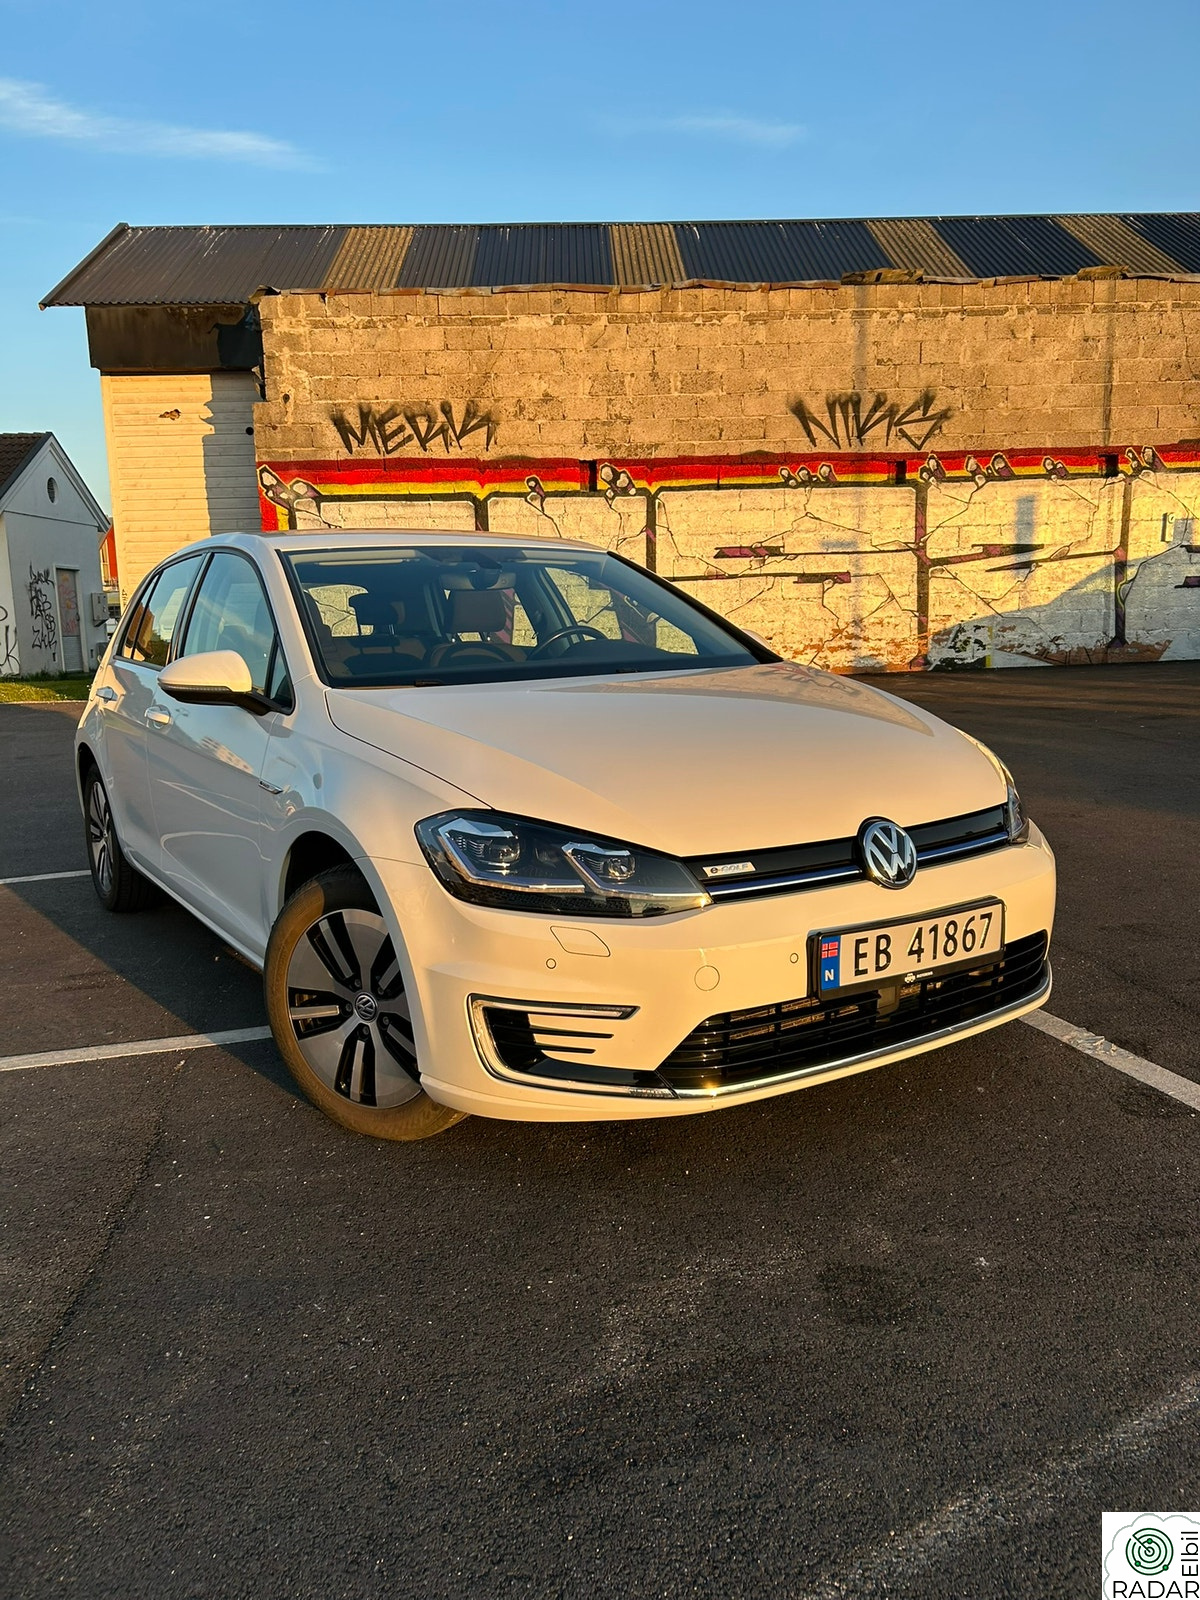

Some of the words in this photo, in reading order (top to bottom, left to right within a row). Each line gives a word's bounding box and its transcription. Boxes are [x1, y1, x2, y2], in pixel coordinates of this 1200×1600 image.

[854, 933, 892, 977] EB
[907, 911, 993, 964] 41867
[824, 968, 835, 982] N
